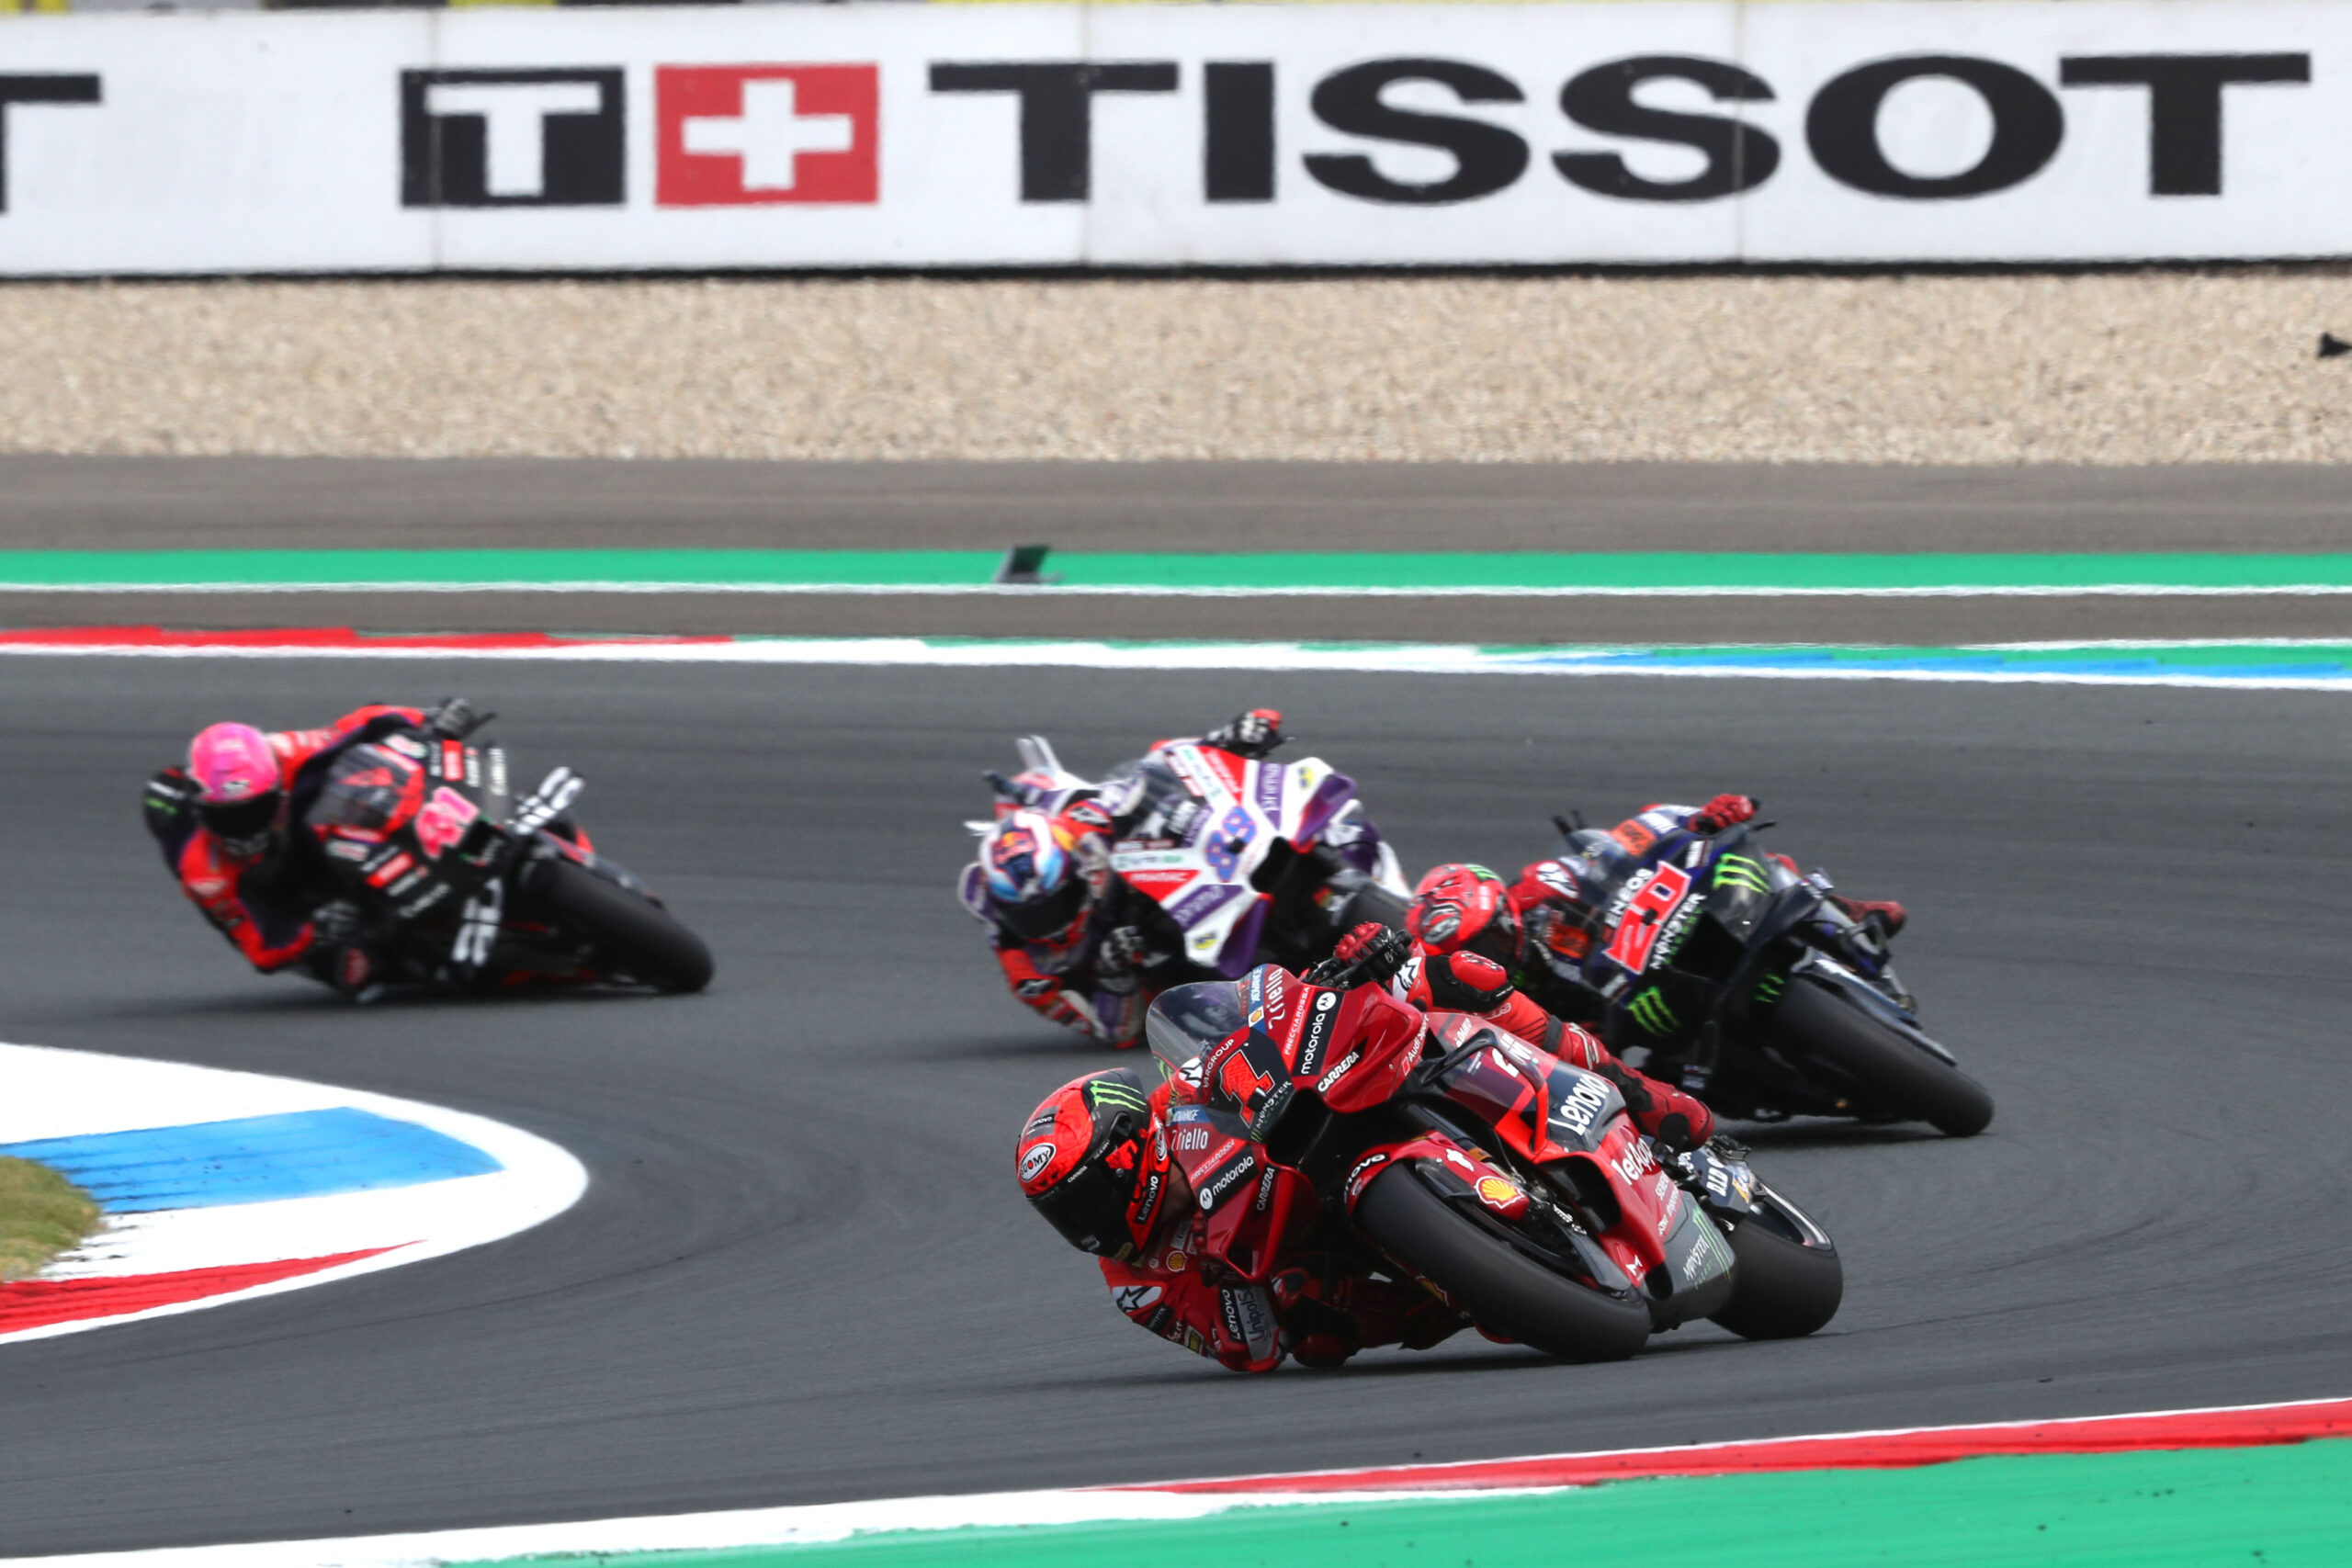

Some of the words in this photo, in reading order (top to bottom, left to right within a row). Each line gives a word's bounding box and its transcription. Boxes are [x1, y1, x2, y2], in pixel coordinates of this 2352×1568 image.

[928, 51, 2311, 206] TISSOT
[1204, 806, 1257, 884] 89
[1601, 860, 1692, 976] 20
[1604, 868, 1654, 929] ENEOS
[1649, 893, 1707, 970] MONSTER
[1284, 987, 1310, 1055] FRECCIAROSSA
[1301, 1012, 1326, 1075] motorola
[1408, 1040, 1422, 1064] Audi
[1418, 1014, 1430, 1042] Sport
[1203, 1039, 1235, 1089] VARGROUP
[1317, 1051, 1360, 1092] CARRERA
[1256, 1081, 1292, 1129] MONSTER
[1547, 1073, 1611, 1136] Lenovo
[1020, 1151, 1050, 1177] SUOMY
[1212, 1156, 1254, 1196] motorola
[1257, 1167, 1275, 1211] CARRERA
[1137, 1176, 1159, 1221] Lenovo
[1682, 1235, 1710, 1280] MONSTER
[1221, 1289, 1241, 1340] Lenovo
